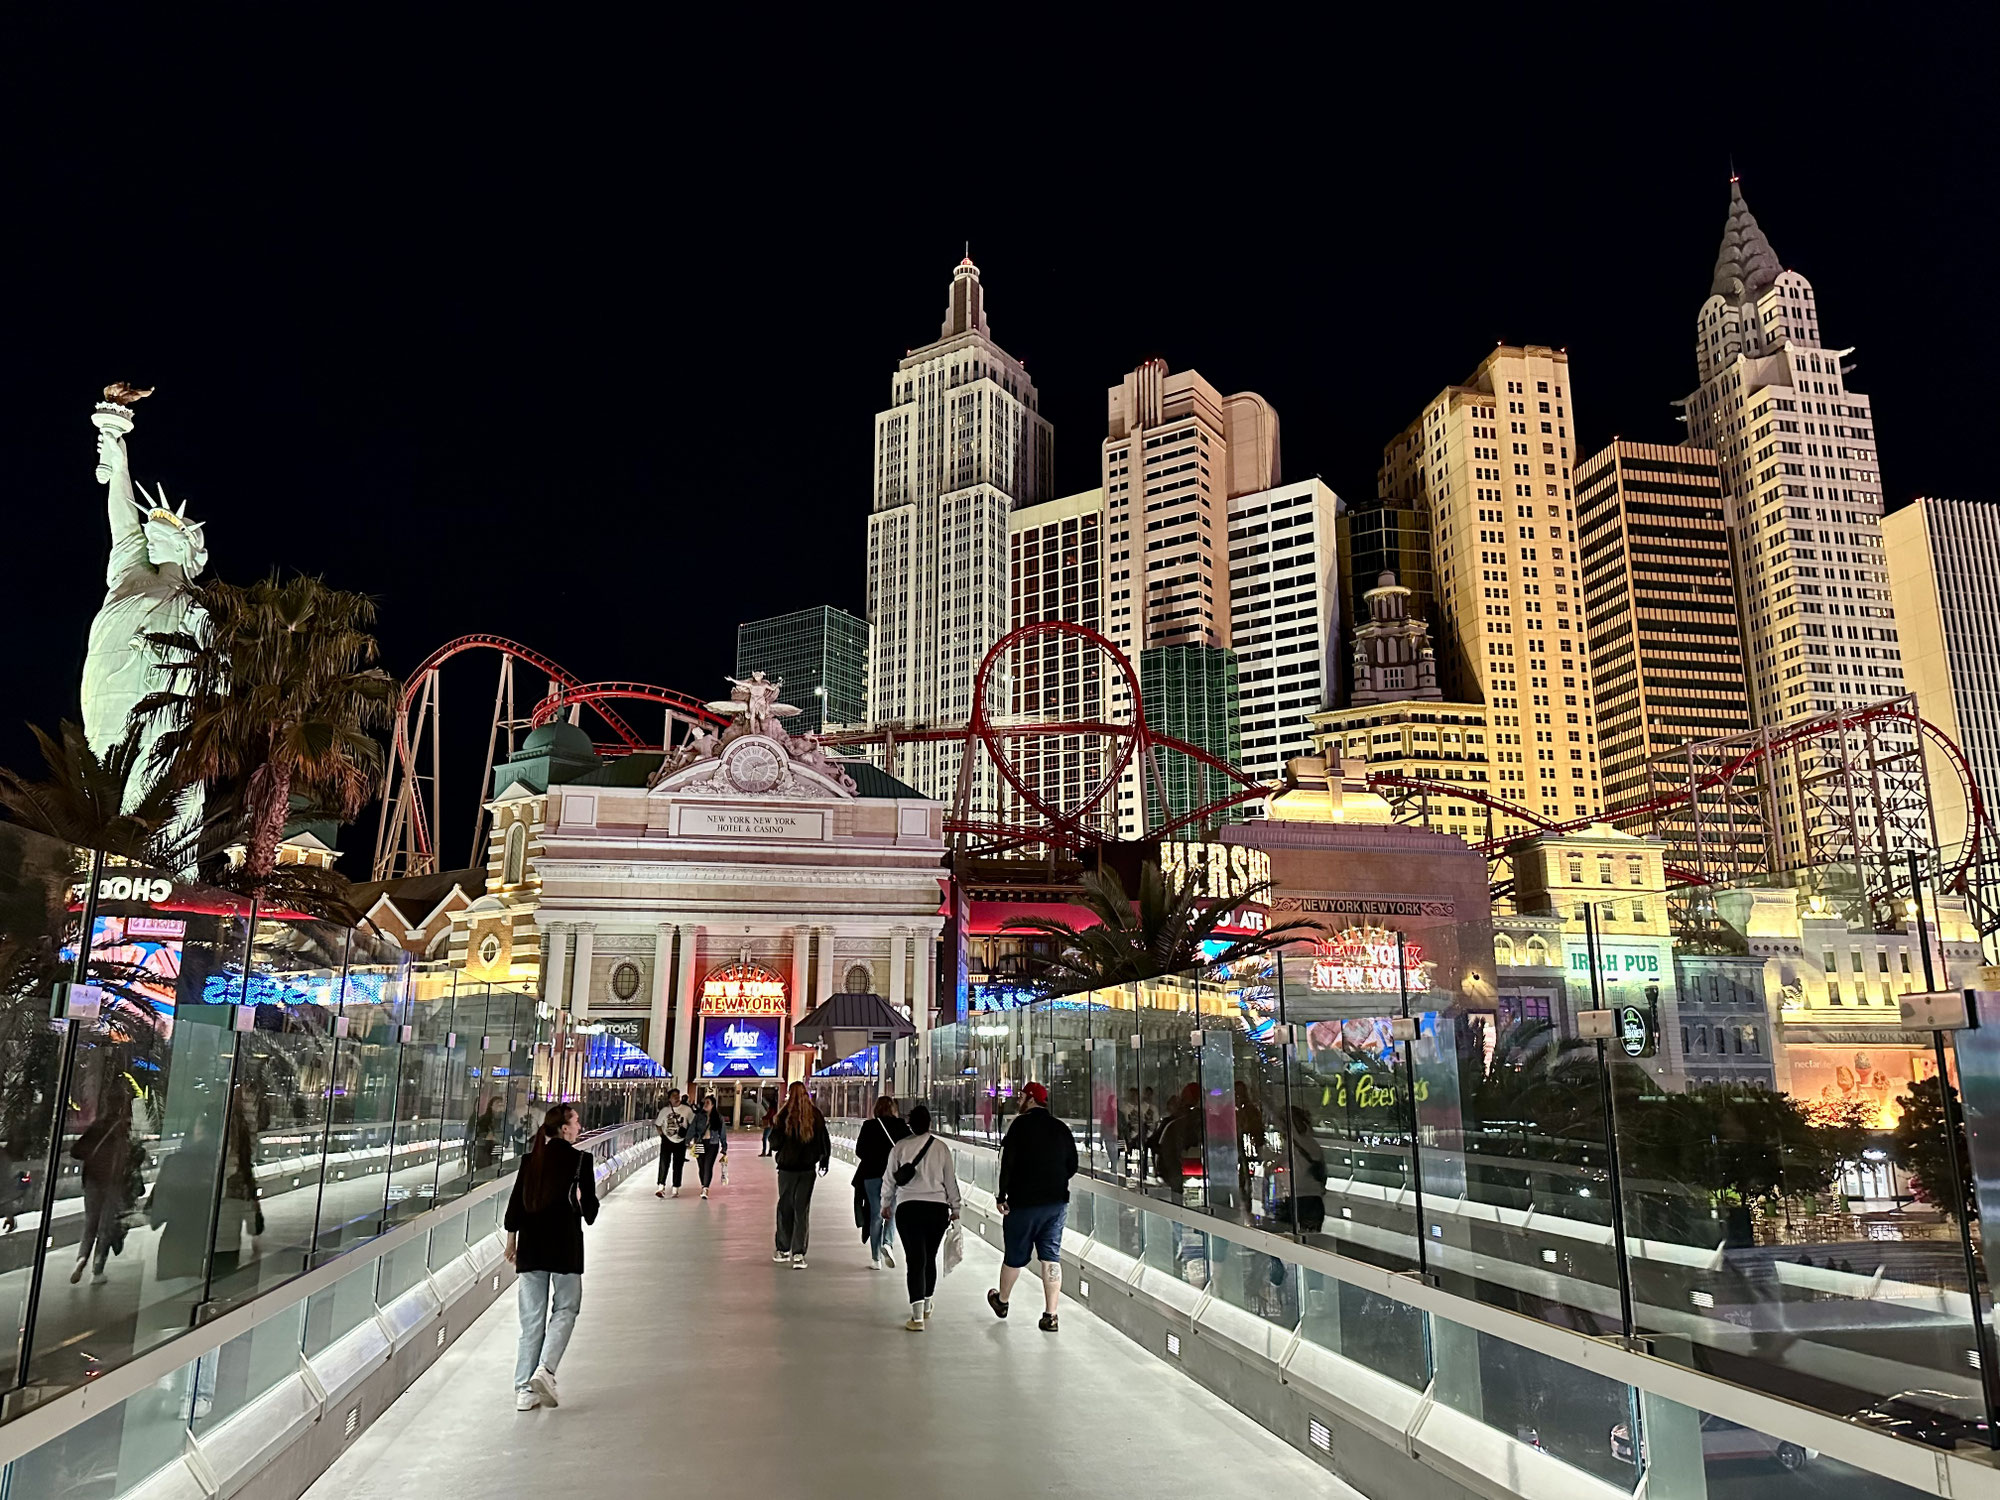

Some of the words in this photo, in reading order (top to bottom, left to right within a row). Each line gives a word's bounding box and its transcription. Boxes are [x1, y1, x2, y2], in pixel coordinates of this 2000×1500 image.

[706, 815, 726, 823] NEW
[728, 816, 751, 824] YORK
[753, 816, 772, 824] NEW
[774, 817, 797, 826] YORK
[717, 824, 742, 832] HOTEL
[753, 825, 784, 834] CASINO
[1571, 953, 1619, 971] IRH
[1624, 954, 1659, 972] PUB
[1316, 966, 1364, 988] NEW
[703, 997, 739, 1011] NEW
[742, 997, 783, 1011] YORK
[606, 1022, 638, 1034] TOM'S
[1827, 1032, 1858, 1043] NEW
[1861, 1032, 1897, 1043] YORK
